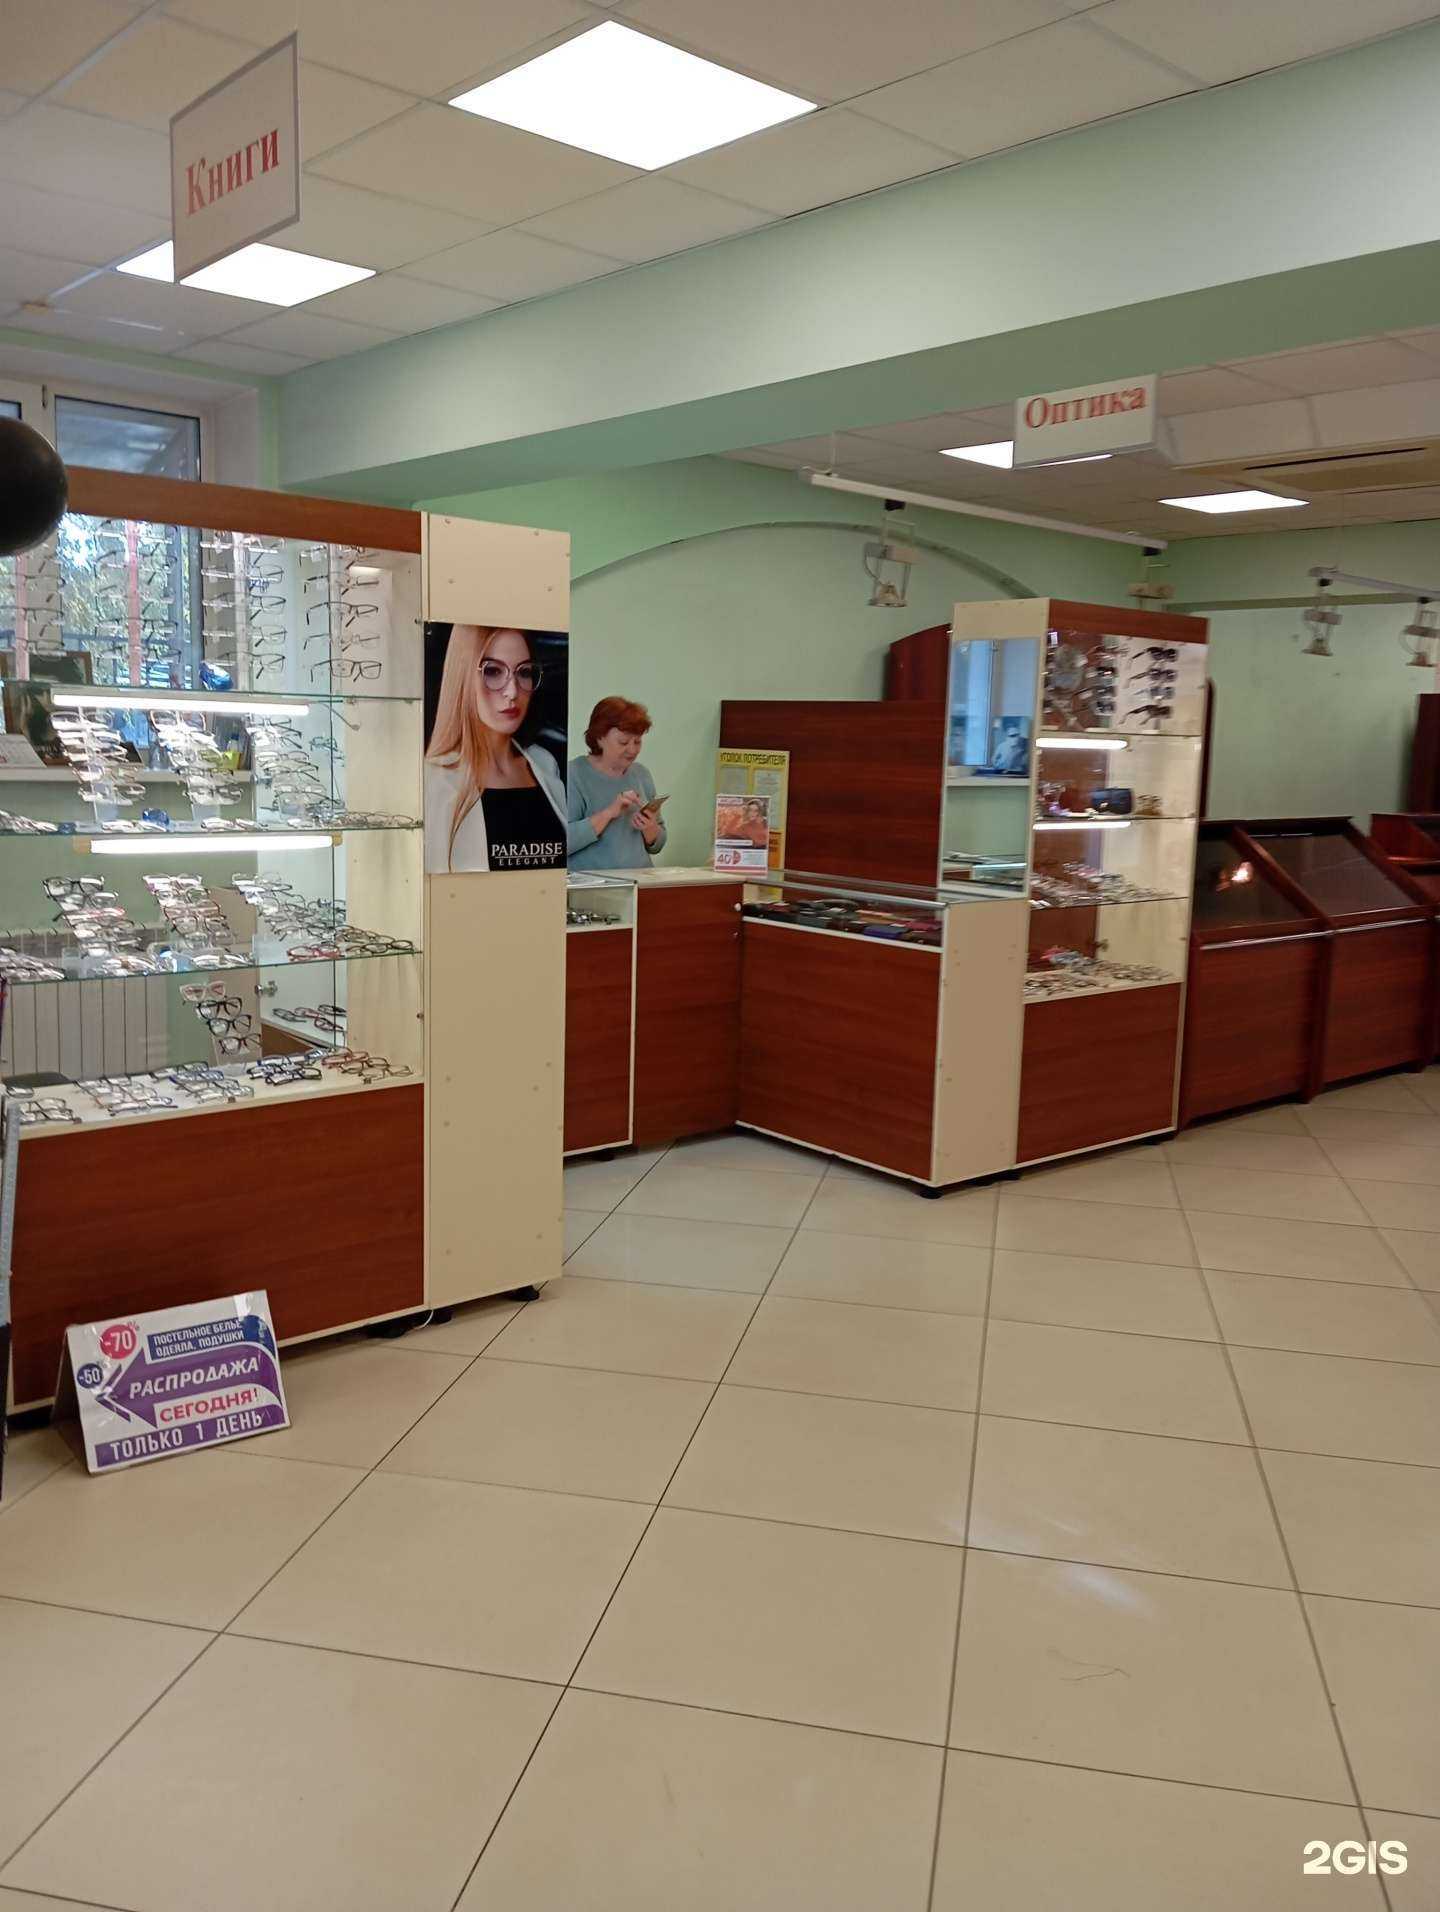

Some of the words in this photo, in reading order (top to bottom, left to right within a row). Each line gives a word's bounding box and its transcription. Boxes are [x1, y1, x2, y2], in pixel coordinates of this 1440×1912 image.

[185, 129, 279, 216] Книги
[1025, 387, 1146, 428] Оптика
[491, 842, 563, 857] PARADISE
[499, 857, 555, 866] ELEGANT
[153, 1325, 212, 1346] ПОСТЕЛЬНОЕ
[199, 1331, 245, 1348] ПОДУШКИ
[129, 1357, 259, 1399] РАСПРОДАЖА
[110, 1428, 184, 1460] ТОЛЬКО
[195, 1424, 204, 1441] 1
[215, 1408, 264, 1438] ДЕНЬ
